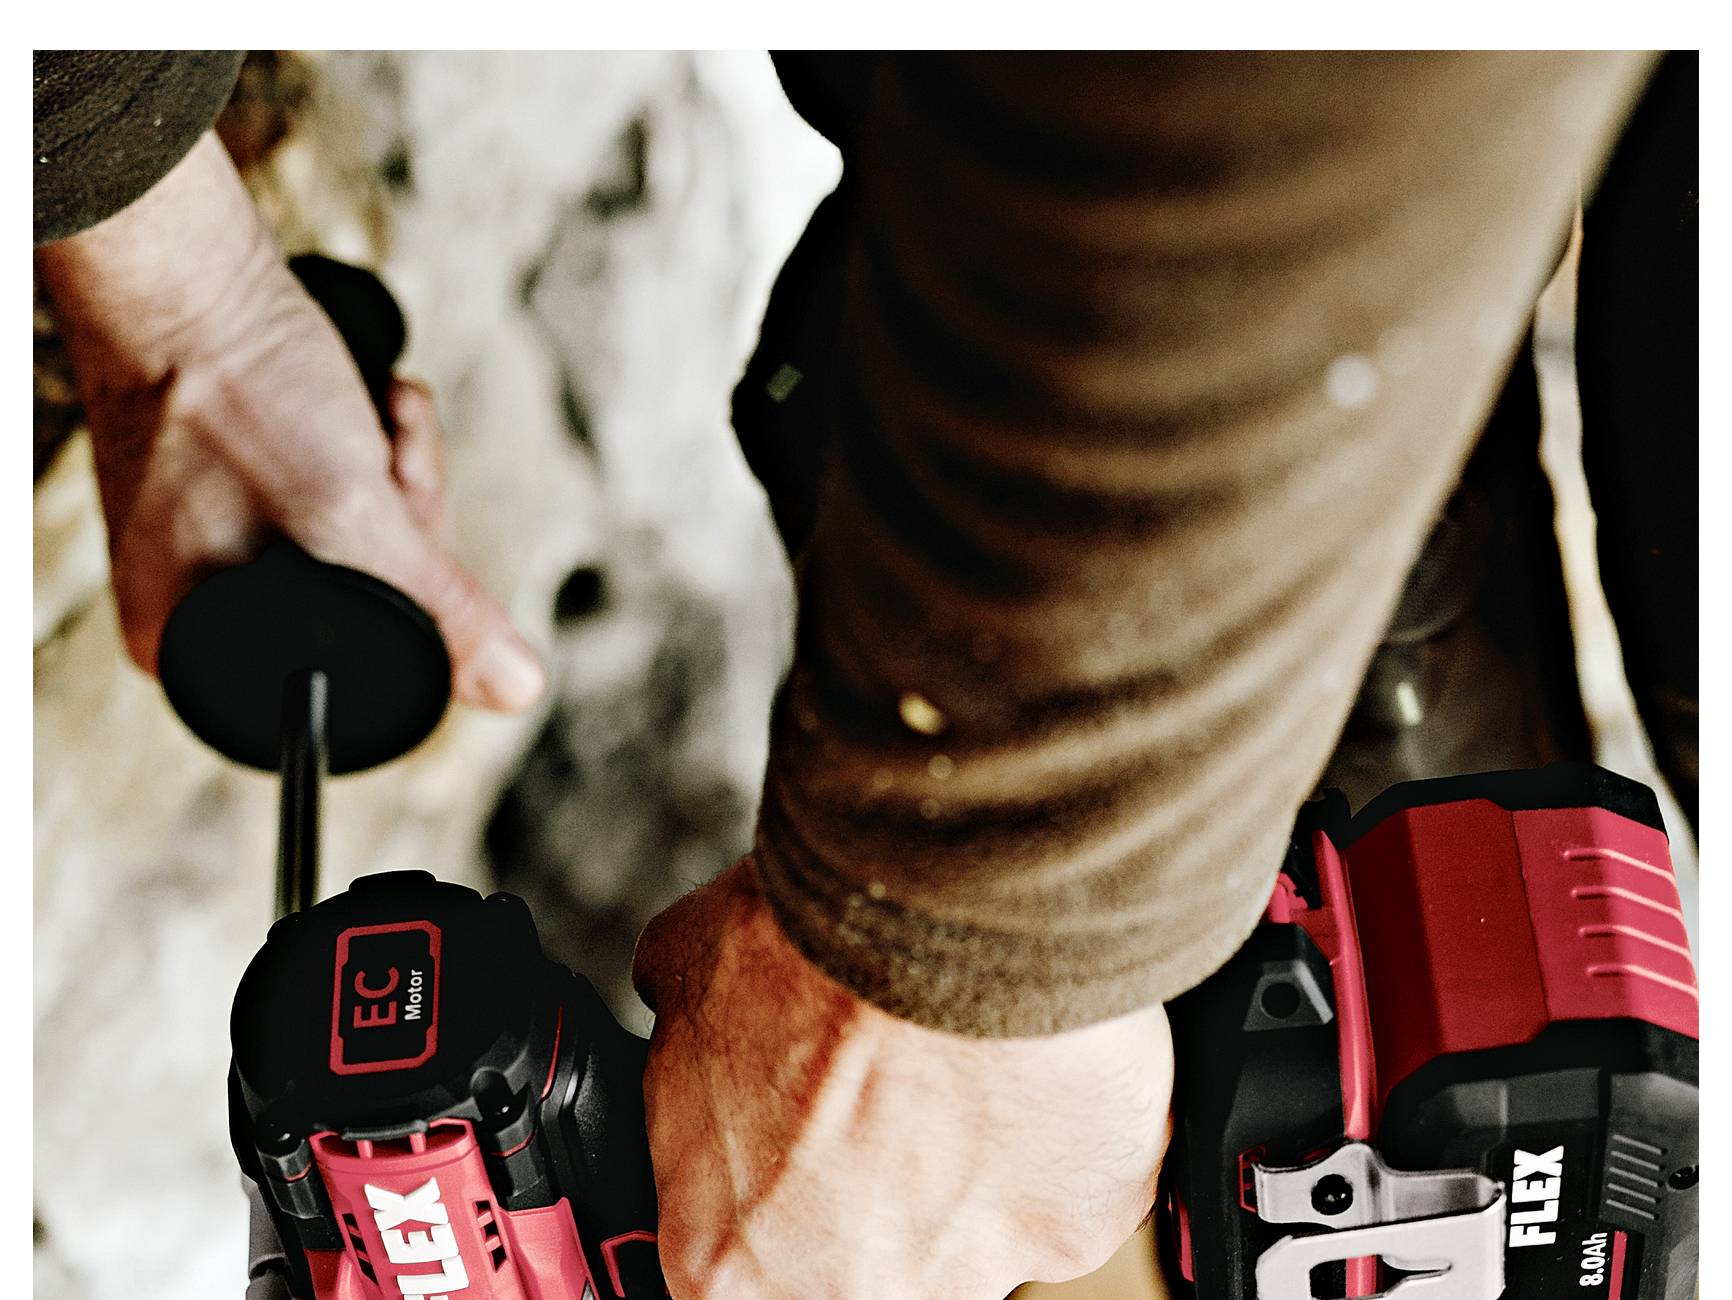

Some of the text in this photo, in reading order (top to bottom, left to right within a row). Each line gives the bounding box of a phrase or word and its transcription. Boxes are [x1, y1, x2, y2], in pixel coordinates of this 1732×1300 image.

[353, 966, 402, 1028] EC
[404, 968, 424, 1021] Motor
[1509, 1145, 1564, 1248] FLEX
[1579, 1232, 1608, 1287] 8.0Ah
